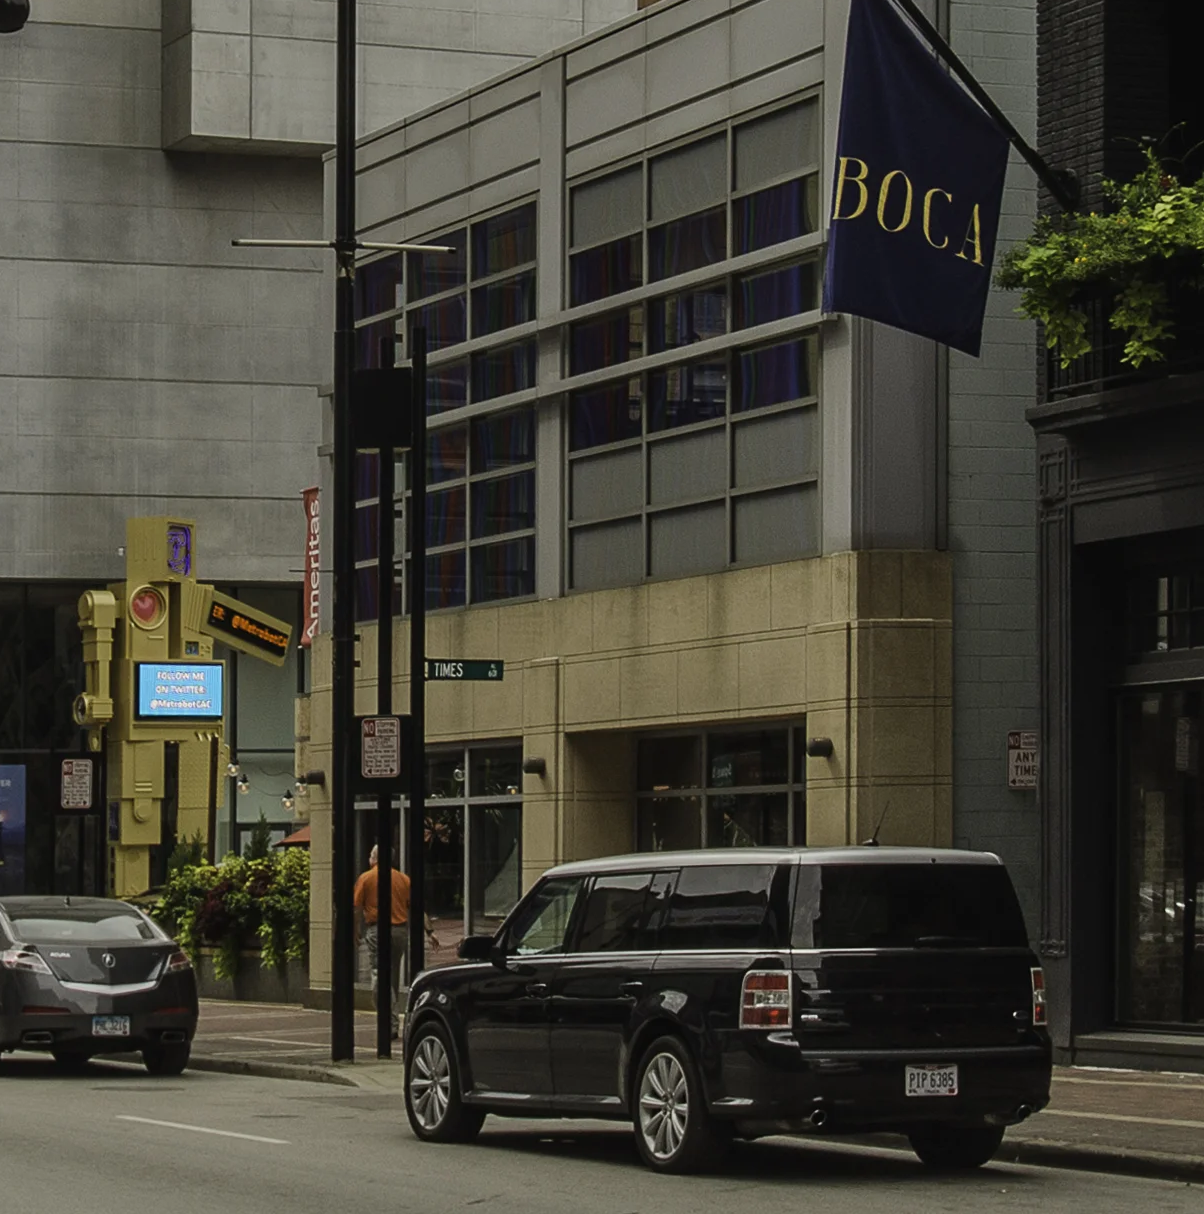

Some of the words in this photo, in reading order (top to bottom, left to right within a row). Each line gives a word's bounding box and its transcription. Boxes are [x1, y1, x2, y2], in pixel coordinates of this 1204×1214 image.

[833, 157, 984, 267] BOCA
[309, 498, 320, 639] Ameritas
[157, 672, 190, 681] FOLLOW
[192, 672, 204, 681] ME
[434, 663, 463, 678] TIMES
[156, 686, 169, 694] ON
[1015, 751, 1036, 763] ANY
[1014, 764, 1037, 776] TIME
[909, 1072, 928, 1088] PIP
[929, 1072, 955, 1088] 6385
